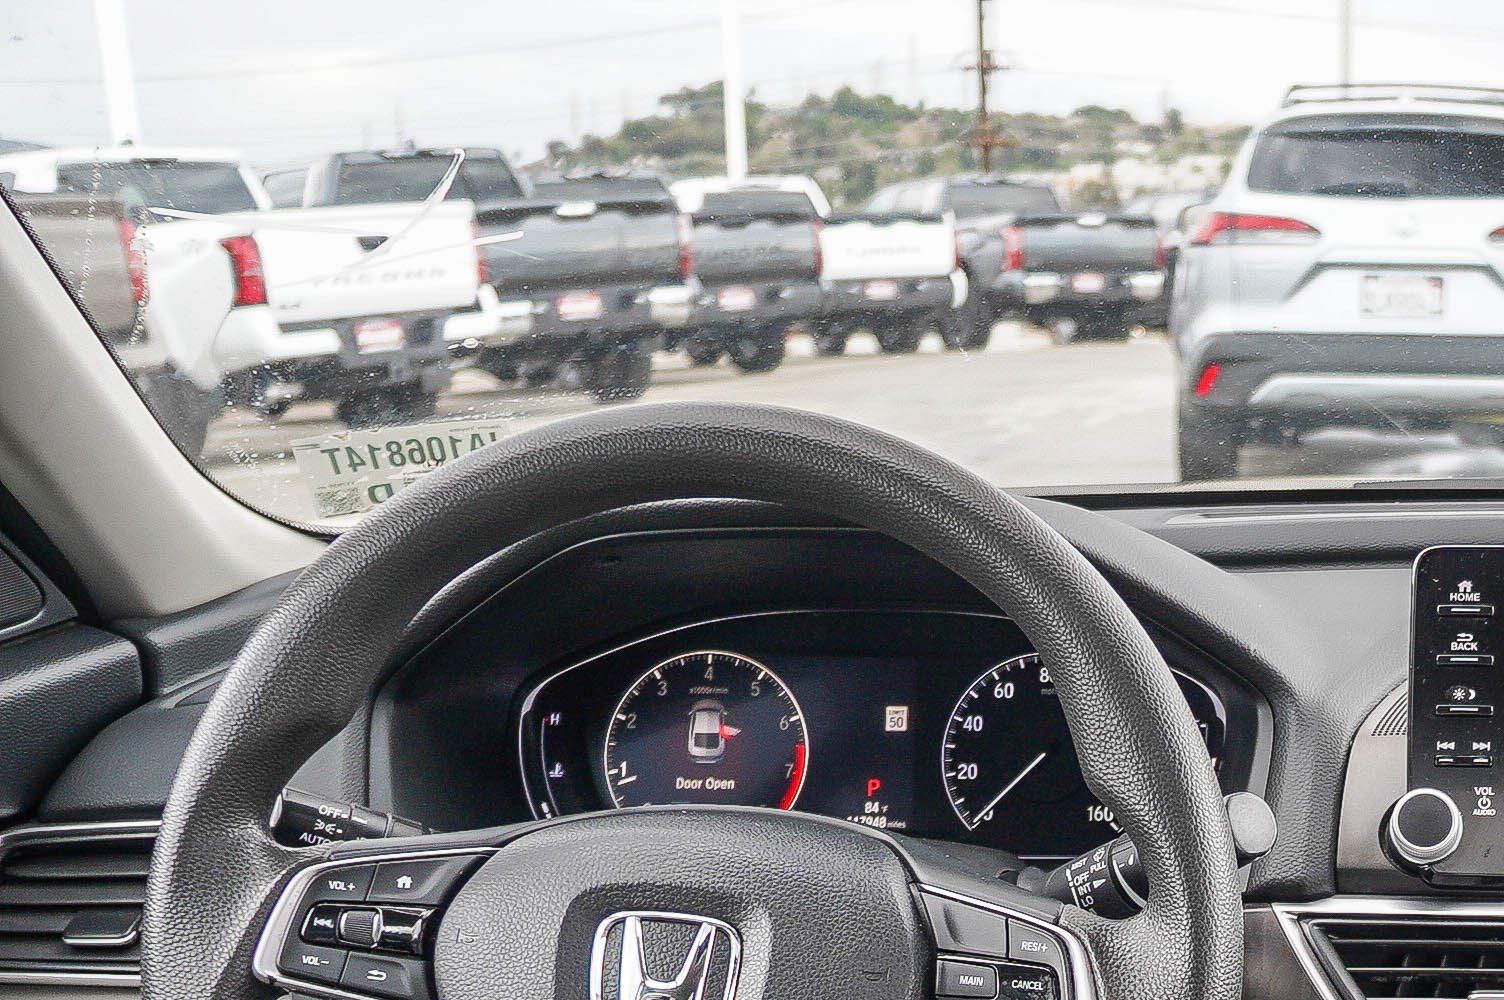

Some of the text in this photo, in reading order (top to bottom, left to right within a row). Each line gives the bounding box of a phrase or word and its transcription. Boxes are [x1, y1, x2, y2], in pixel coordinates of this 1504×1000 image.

[1449, 592, 1481, 602] HOME
[1450, 642, 1478, 651] BACK
[704, 668, 713, 681] 4
[657, 682, 668, 697] 3
[751, 682, 760, 697] 5
[994, 682, 1015, 699] 60
[550, 712, 561, 726] H
[627, 714, 637, 729] 2
[779, 716, 791, 731] 6
[889, 717, 904, 728] 50
[963, 715, 984, 732] 40
[619, 761, 627, 777] 1
[785, 763, 794, 778] 7
[957, 763, 978, 780] 20
[675, 777, 735, 791] Door Open
[867, 778, 881, 797] P
[1473, 787, 1496, 796] VOL
[318, 804, 343, 819] OFF
[864, 801, 880, 814] 84
[1087, 805, 1115, 822] 160
[1472, 808, 1497, 816] AUDIO
[1073, 870, 1090, 886] OFF
[1077, 882, 1092, 896] INT
[1080, 895, 1094, 907] LO
[959, 974, 984, 987] MAIN
[1011, 979, 1045, 991] CANCEL
